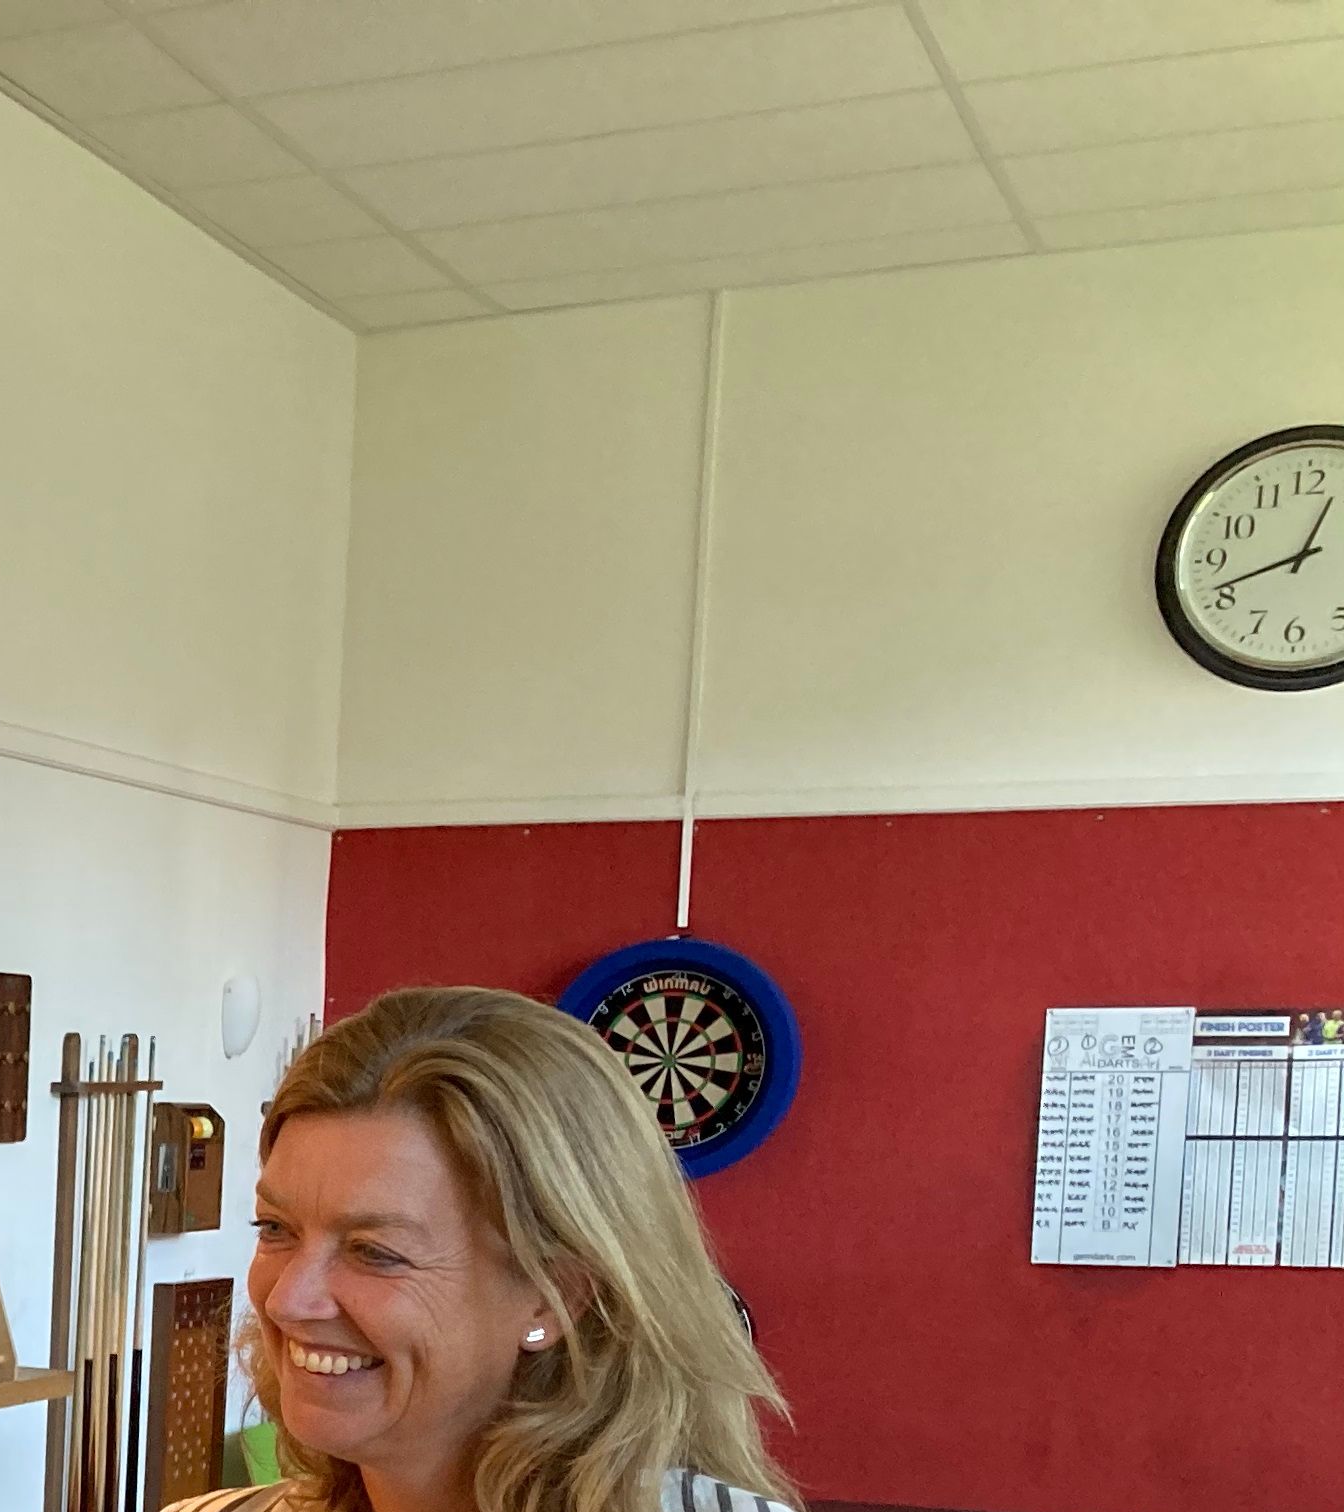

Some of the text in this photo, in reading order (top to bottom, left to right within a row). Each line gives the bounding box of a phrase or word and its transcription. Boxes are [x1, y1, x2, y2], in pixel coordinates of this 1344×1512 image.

[1290, 469, 1326, 496] 12
[1254, 483, 1281, 510] 11
[1223, 513, 1255, 541] 10
[1206, 547, 1228, 575] 9
[1215, 584, 1236, 611] 8
[1249, 609, 1268, 635] 7
[1284, 616, 1306, 644] 6
